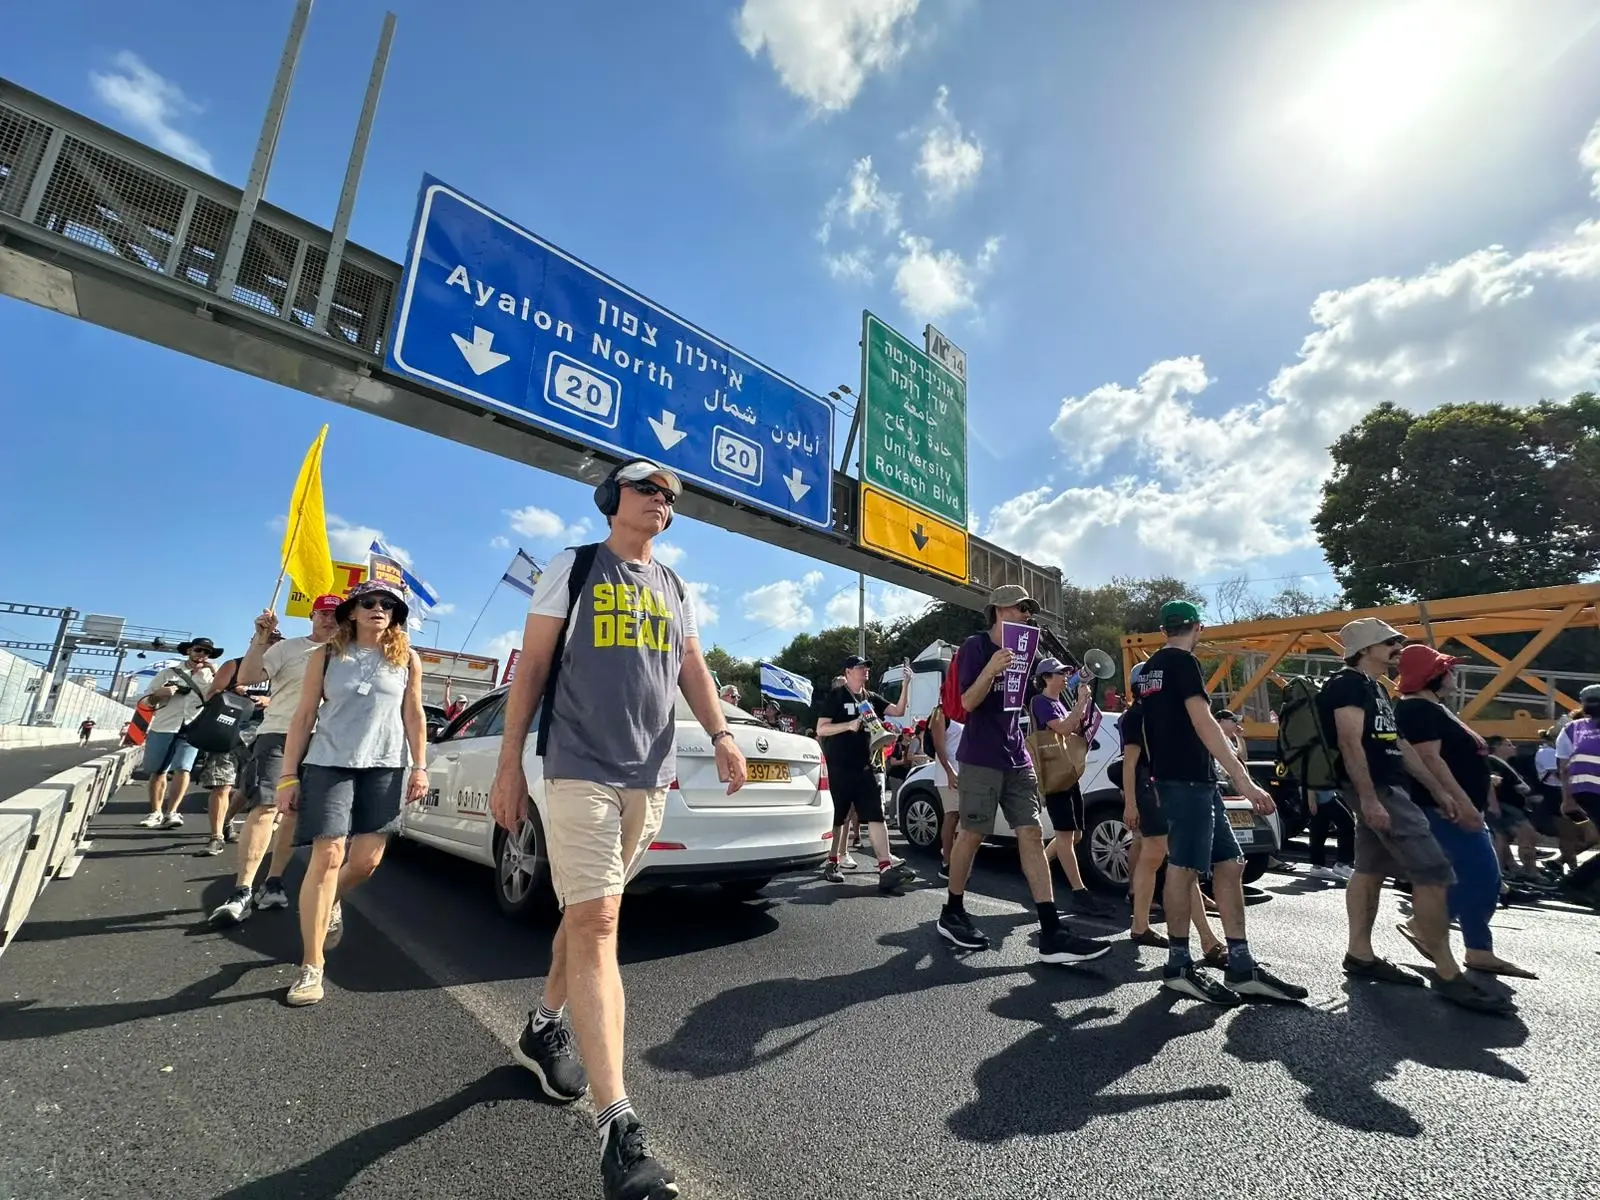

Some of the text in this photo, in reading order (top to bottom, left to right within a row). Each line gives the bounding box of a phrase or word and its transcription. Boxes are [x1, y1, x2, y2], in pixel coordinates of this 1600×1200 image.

[445, 264, 673, 390] Ayalon North
[598, 298, 743, 392] איילון צפון
[884, 341, 953, 400] אוניברסיטה
[891, 367, 920, 399] רוקח
[952, 355, 964, 373] 14
[566, 375, 602, 407] 20
[704, 386, 757, 425] شمال
[904, 396, 938, 430] جامعة
[725, 443, 750, 468] 20
[884, 434, 951, 486] University
[875, 454, 959, 509] Rokach Blvd
[593, 582, 674, 620] SEAL
[593, 614, 672, 652] DEAL
